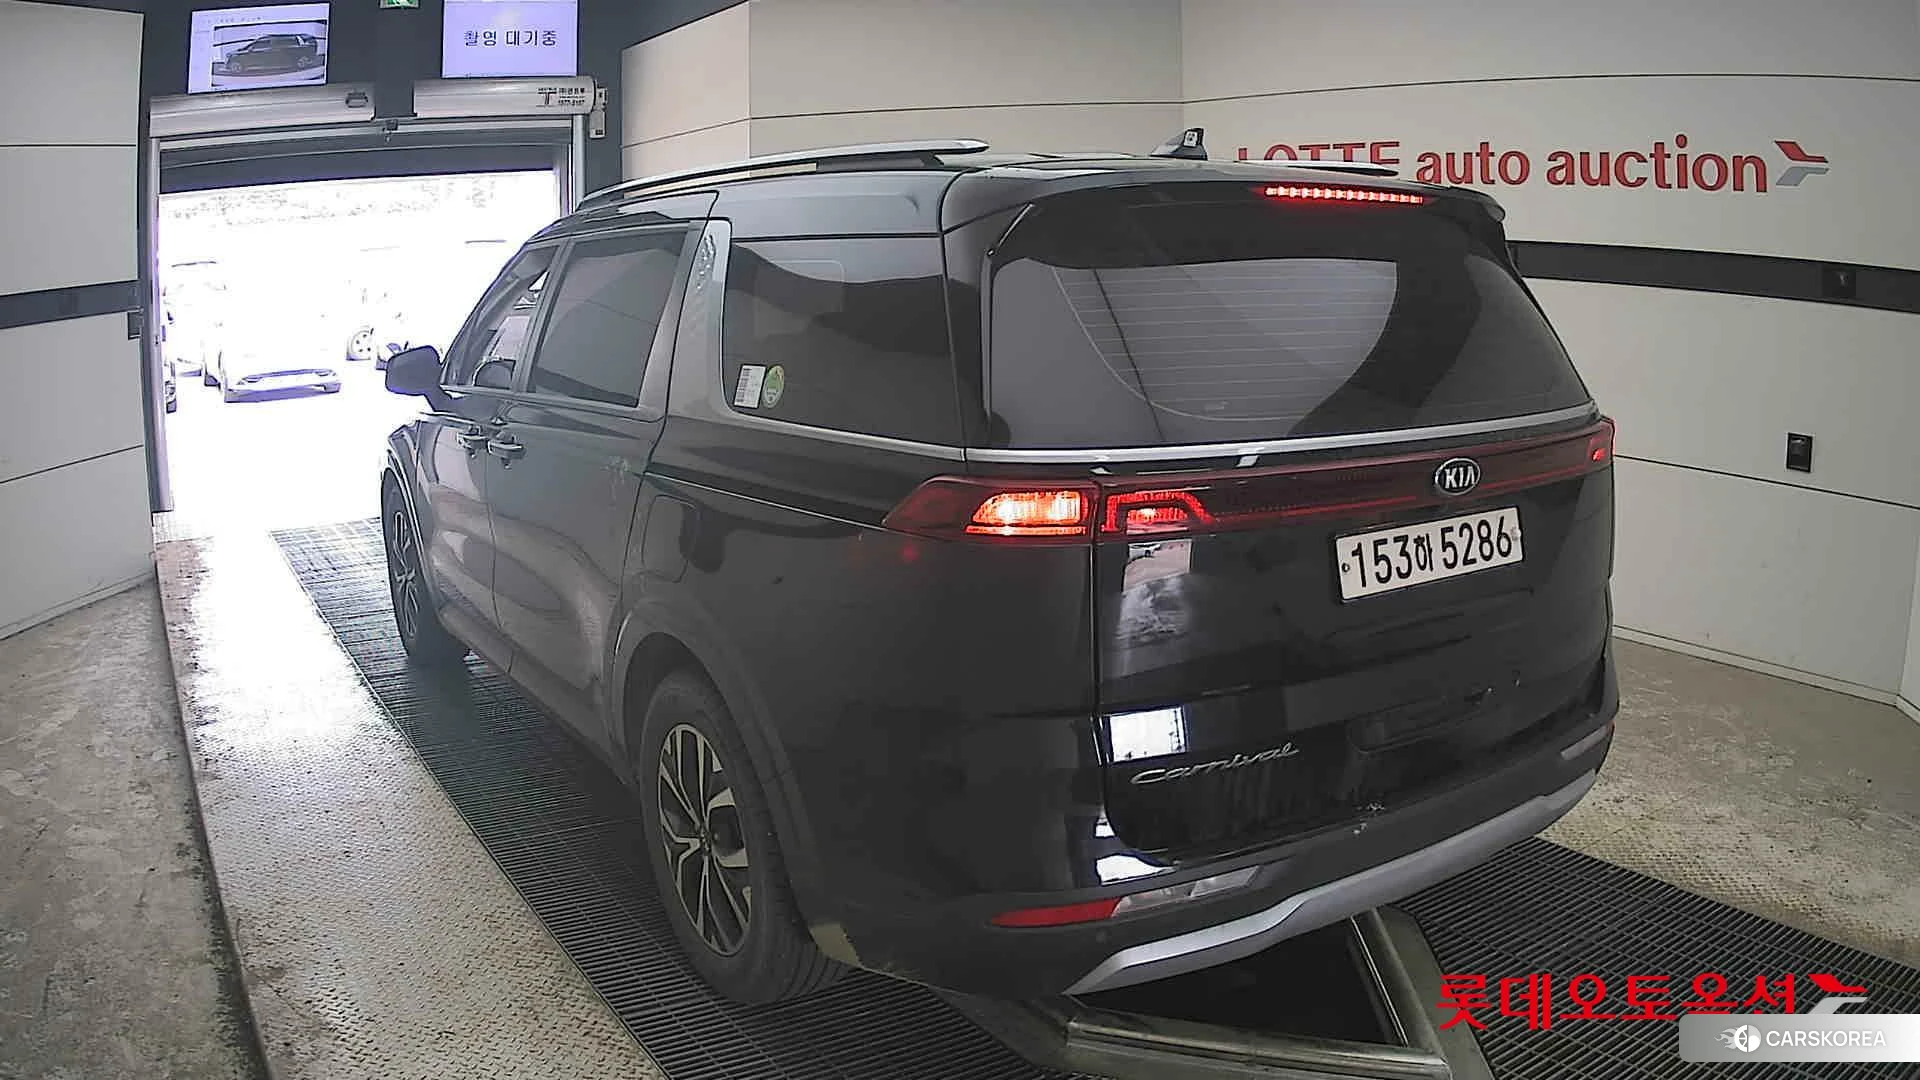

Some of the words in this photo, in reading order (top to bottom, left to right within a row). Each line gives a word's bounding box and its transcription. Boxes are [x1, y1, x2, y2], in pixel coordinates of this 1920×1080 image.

[505, 29, 557, 47] 대기중
[1416, 141, 1531, 186] auto
[1546, 134, 1768, 193] auction
[1444, 466, 1476, 489] KIA
[1352, 533, 1434, 588] 153하
[1440, 516, 1512, 570] 5286
[1130, 742, 1300, 784] Carnival
